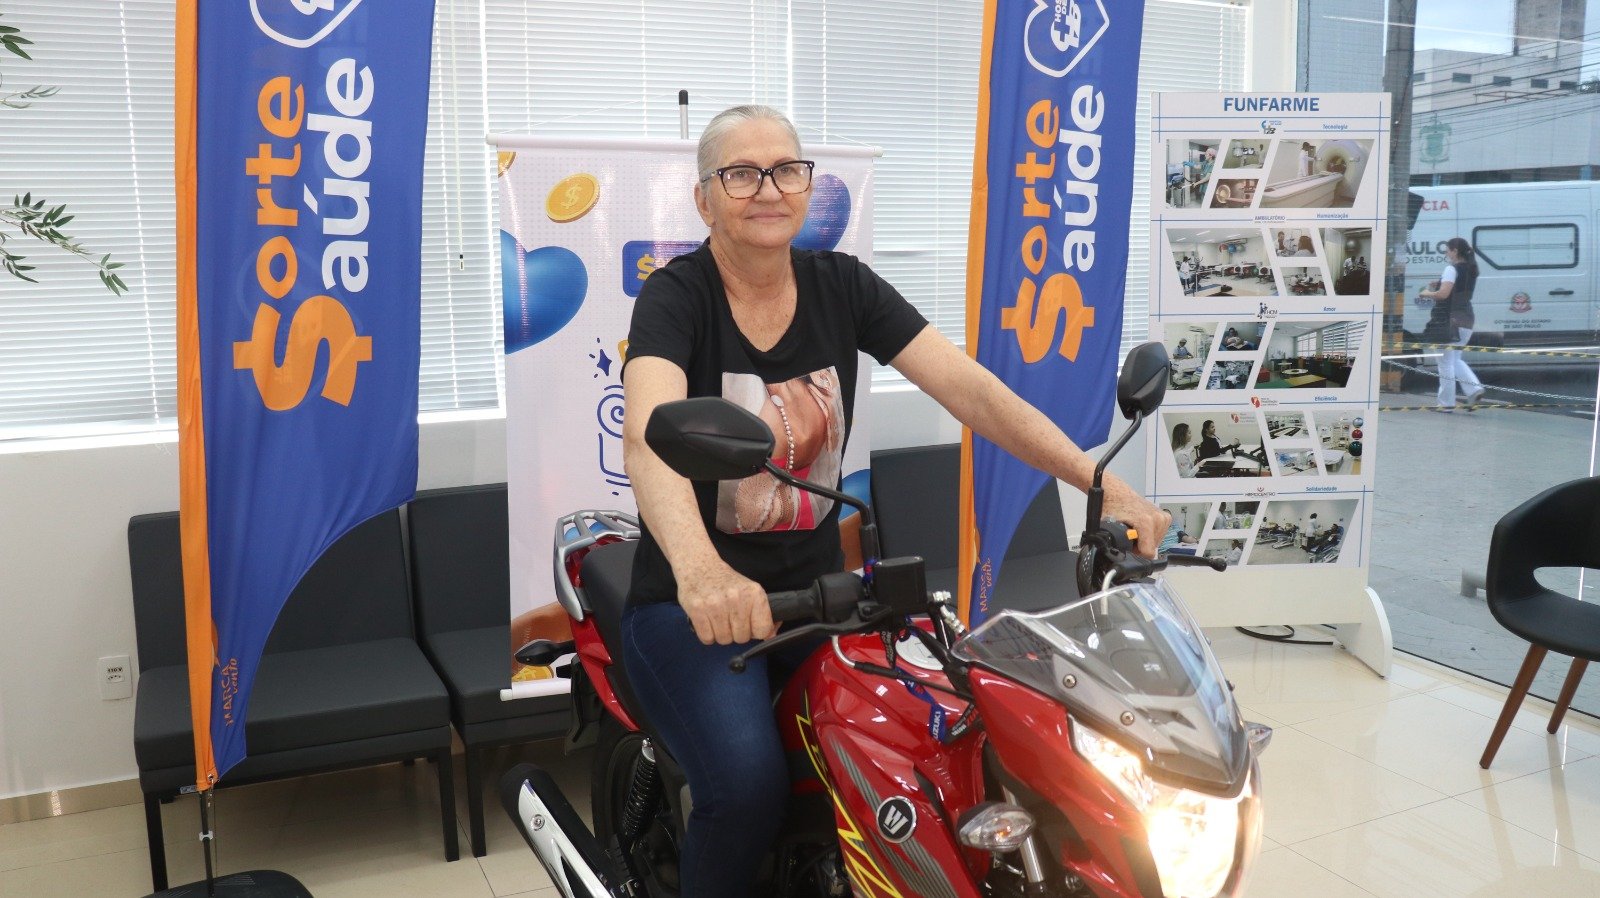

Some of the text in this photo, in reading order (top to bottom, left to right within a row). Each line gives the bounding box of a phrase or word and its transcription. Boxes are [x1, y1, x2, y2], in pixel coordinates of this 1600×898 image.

[1223, 97, 1320, 112] FUNFARME
[1322, 123, 1348, 131] Tecnologia
[1316, 212, 1349, 220] Humanização
[1406, 240, 1448, 255] AULO
[932, 710, 941, 740] UZUKI
